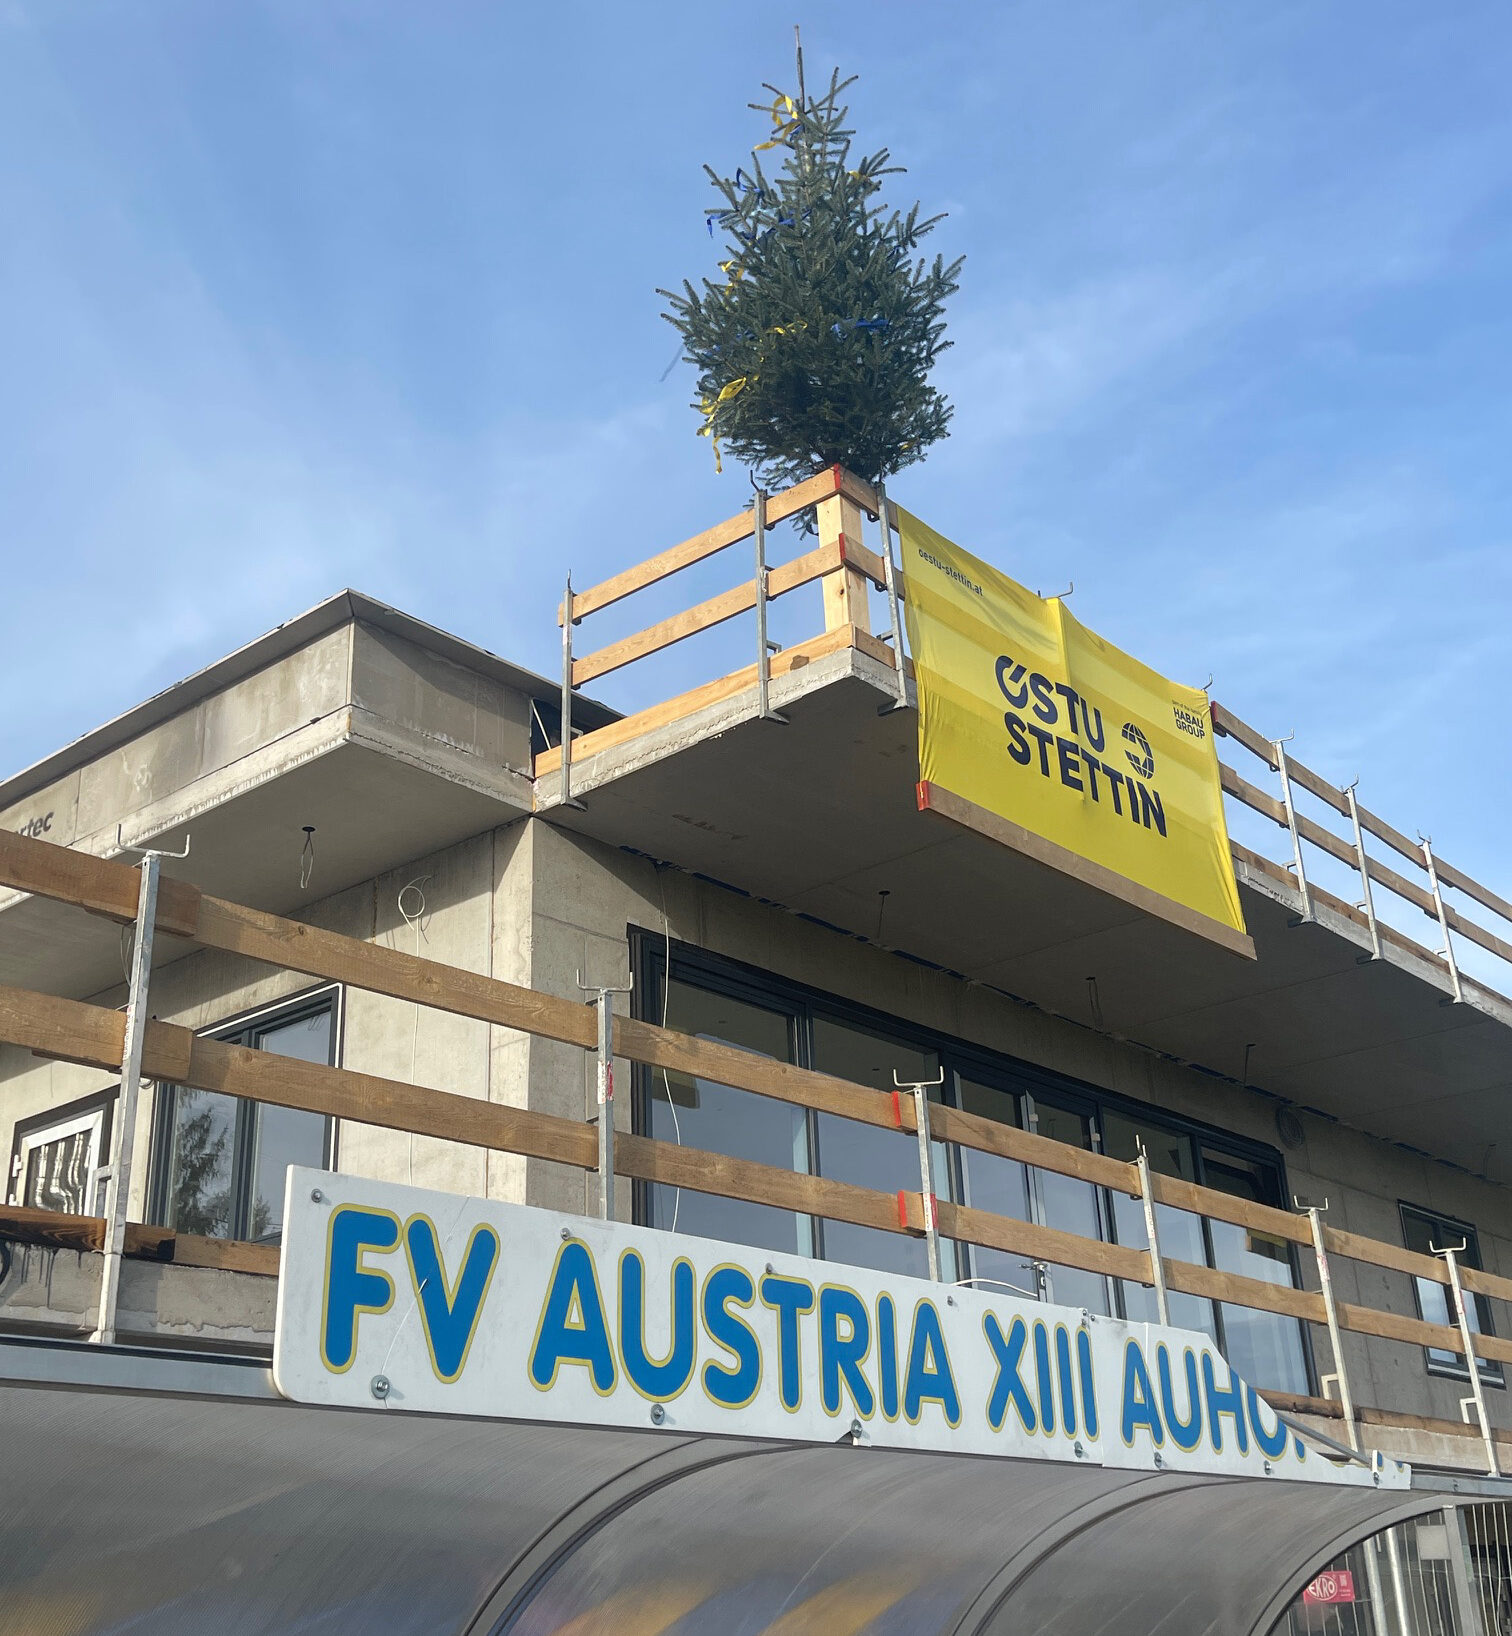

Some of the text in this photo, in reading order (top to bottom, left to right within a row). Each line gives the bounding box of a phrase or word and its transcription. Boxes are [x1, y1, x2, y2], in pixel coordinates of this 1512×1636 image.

[918, 548, 983, 596] oestu-stettin.at
[1173, 706, 1204, 729] HABAU
[1175, 718, 1206, 739] GROUP
[1004, 711, 1168, 838] STETTIN
[320, 1202, 501, 1384] FV
[528, 1236, 962, 1430] AUSTRIA
[982, 1309, 1099, 1441] XIII
